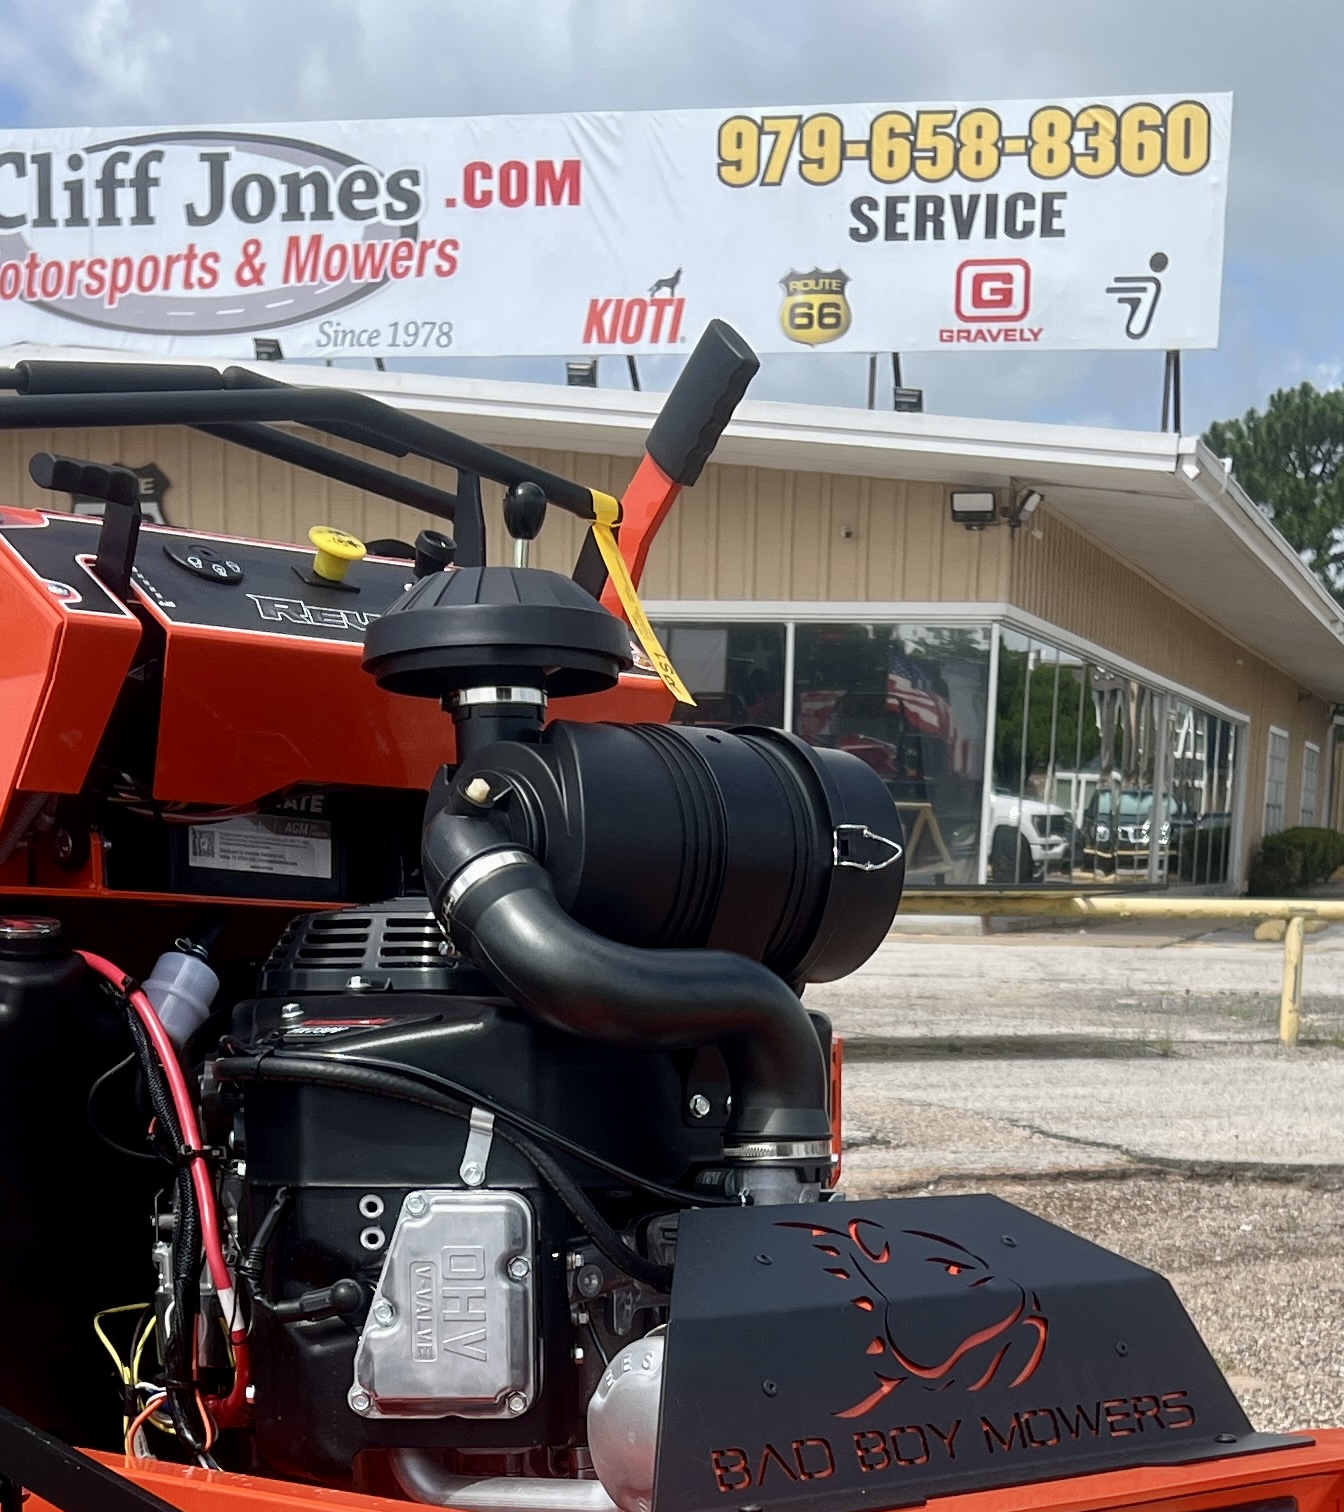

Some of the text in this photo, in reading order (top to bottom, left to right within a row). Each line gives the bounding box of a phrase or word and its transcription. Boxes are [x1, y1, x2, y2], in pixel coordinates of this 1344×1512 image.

[717, 100, 1210, 188] 979-658-8360
[184, 151, 422, 227] Jones
[445, 158, 582, 210] .COM
[849, 190, 1068, 242] SERVICE
[235, 239, 266, 285] &
[282, 233, 460, 286] Mowers
[789, 276, 842, 292] ROUTE
[316, 322, 454, 348] Since 1978
[582, 297, 686, 344] KIOTI
[789, 302, 841, 330] 66
[939, 327, 1043, 343] GRAVELY
[415, 1266, 433, 1359] V-VALVE
[441, 1245, 488, 1363] OHV
[712, 1390, 1196, 1492] BAD BOY MOWERS
